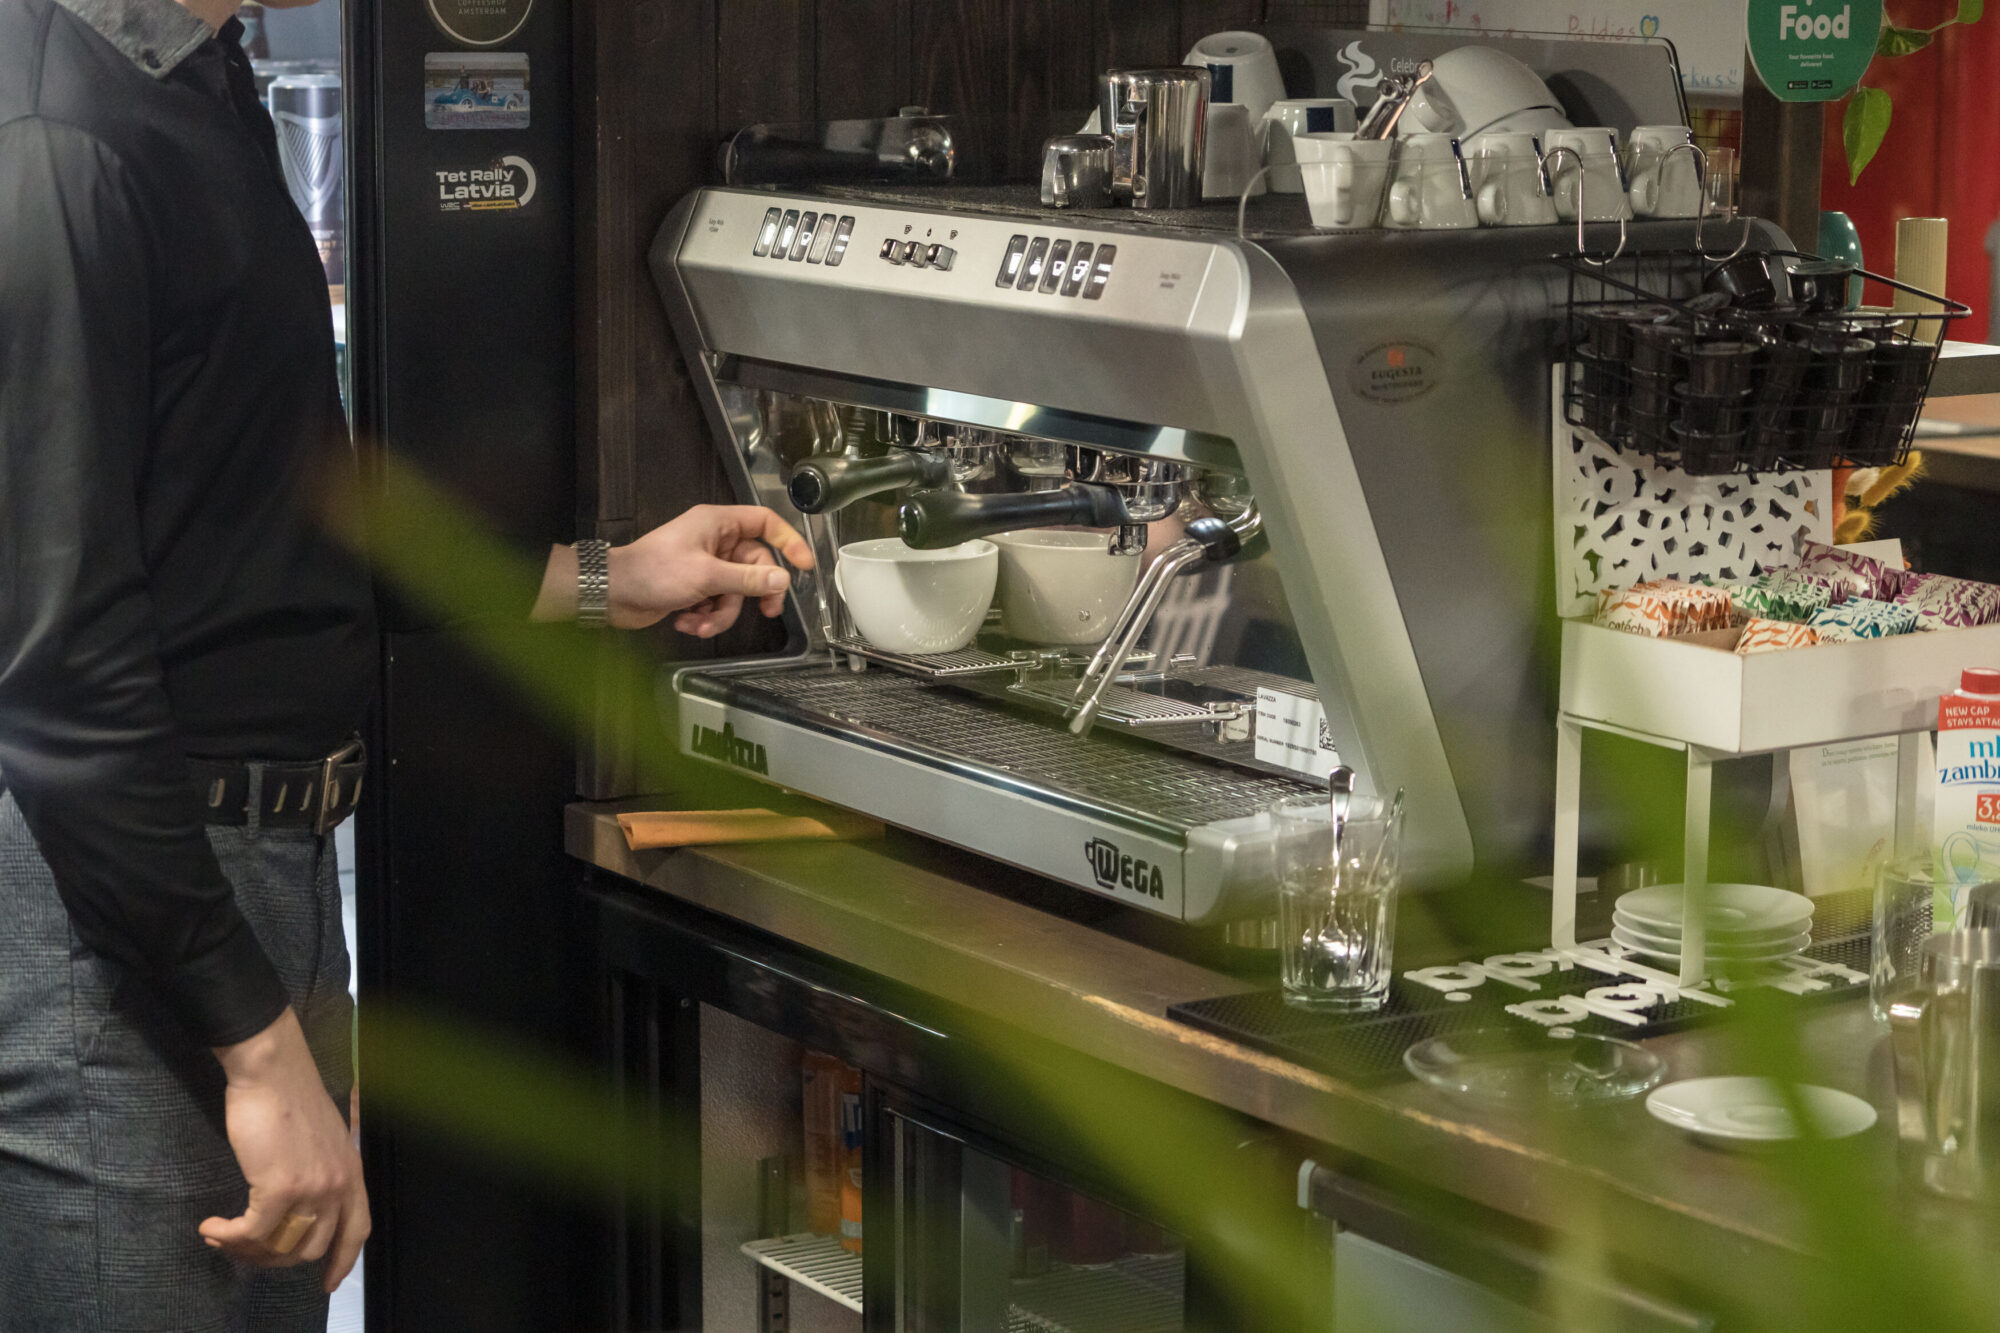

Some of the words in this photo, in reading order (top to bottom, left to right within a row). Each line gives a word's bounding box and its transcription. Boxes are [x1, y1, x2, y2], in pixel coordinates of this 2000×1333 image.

[1780, 5, 1850, 40] Food
[436, 170, 467, 183] Tet
[470, 168, 514, 182] Rally
[440, 181, 515, 200] Latvia
[1945, 707, 1968, 717] NEW
[1970, 705, 1990, 716] CAP
[1947, 718, 1974, 727] STAYS
[1085, 837, 1164, 900] WEGA
